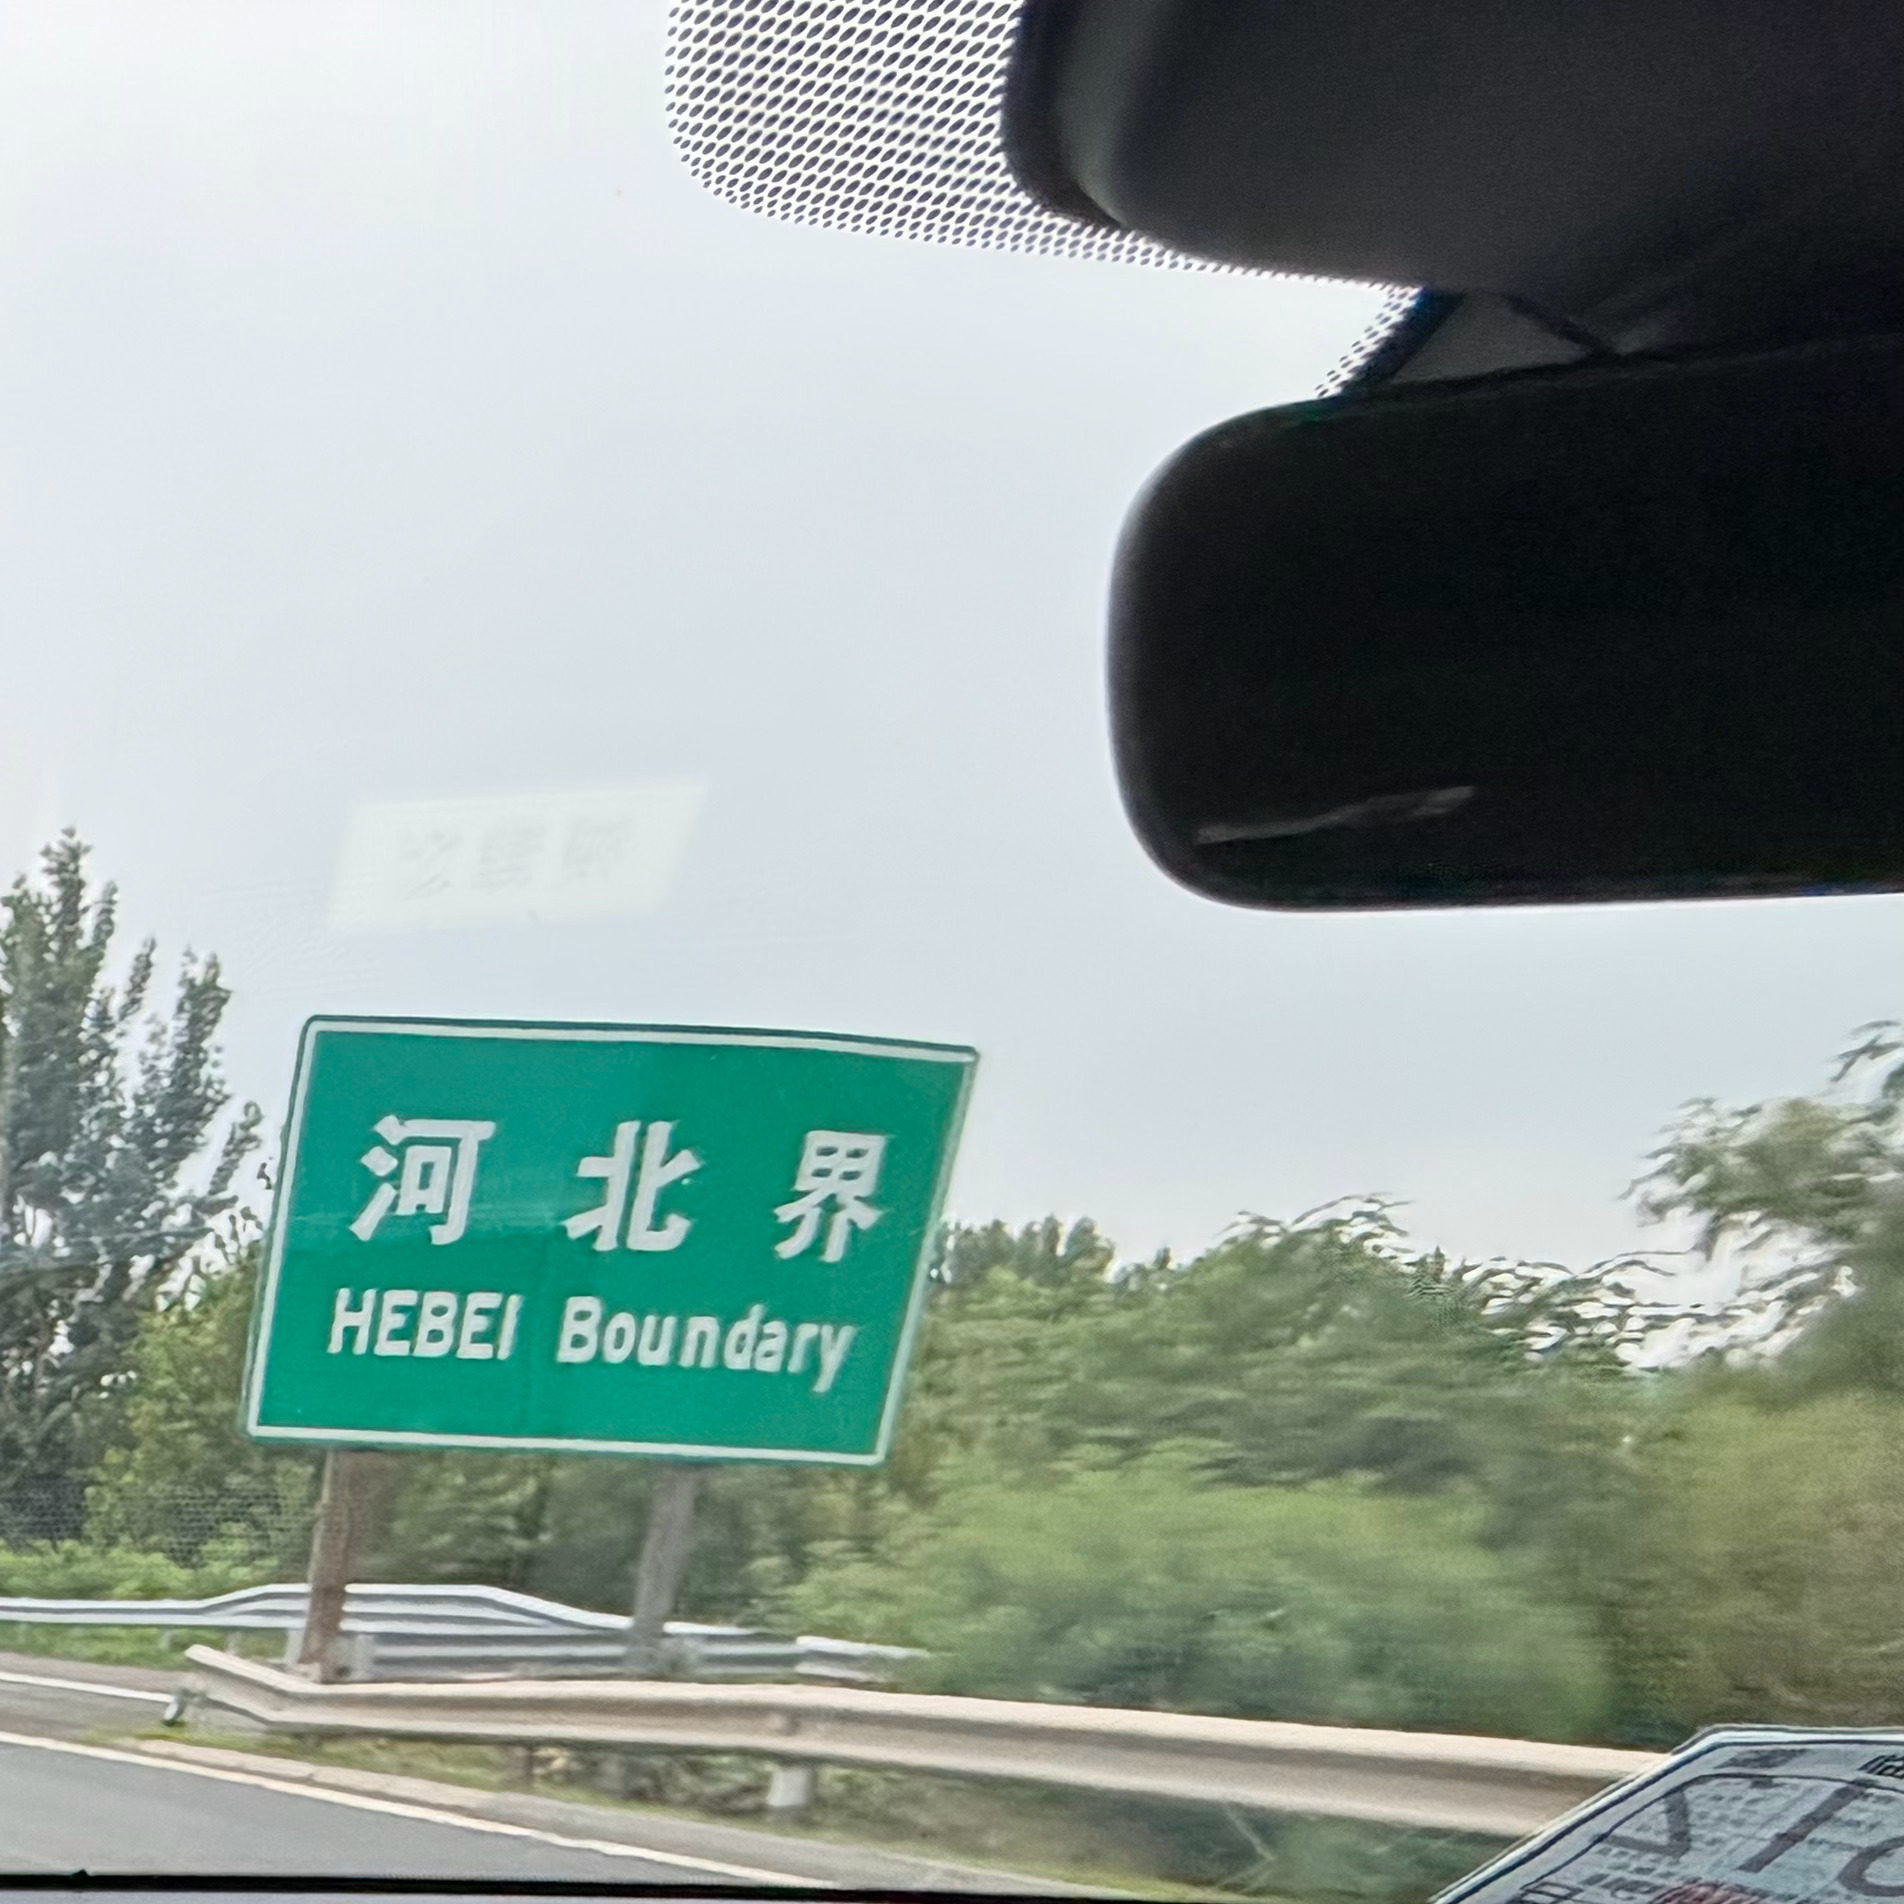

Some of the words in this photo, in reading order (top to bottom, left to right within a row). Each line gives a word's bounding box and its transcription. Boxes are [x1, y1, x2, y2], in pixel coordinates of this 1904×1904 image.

[349, 1115, 894, 1263] 河北界
[328, 1289, 523, 1360] HEBEI
[557, 1297, 855, 1392] Boundary
